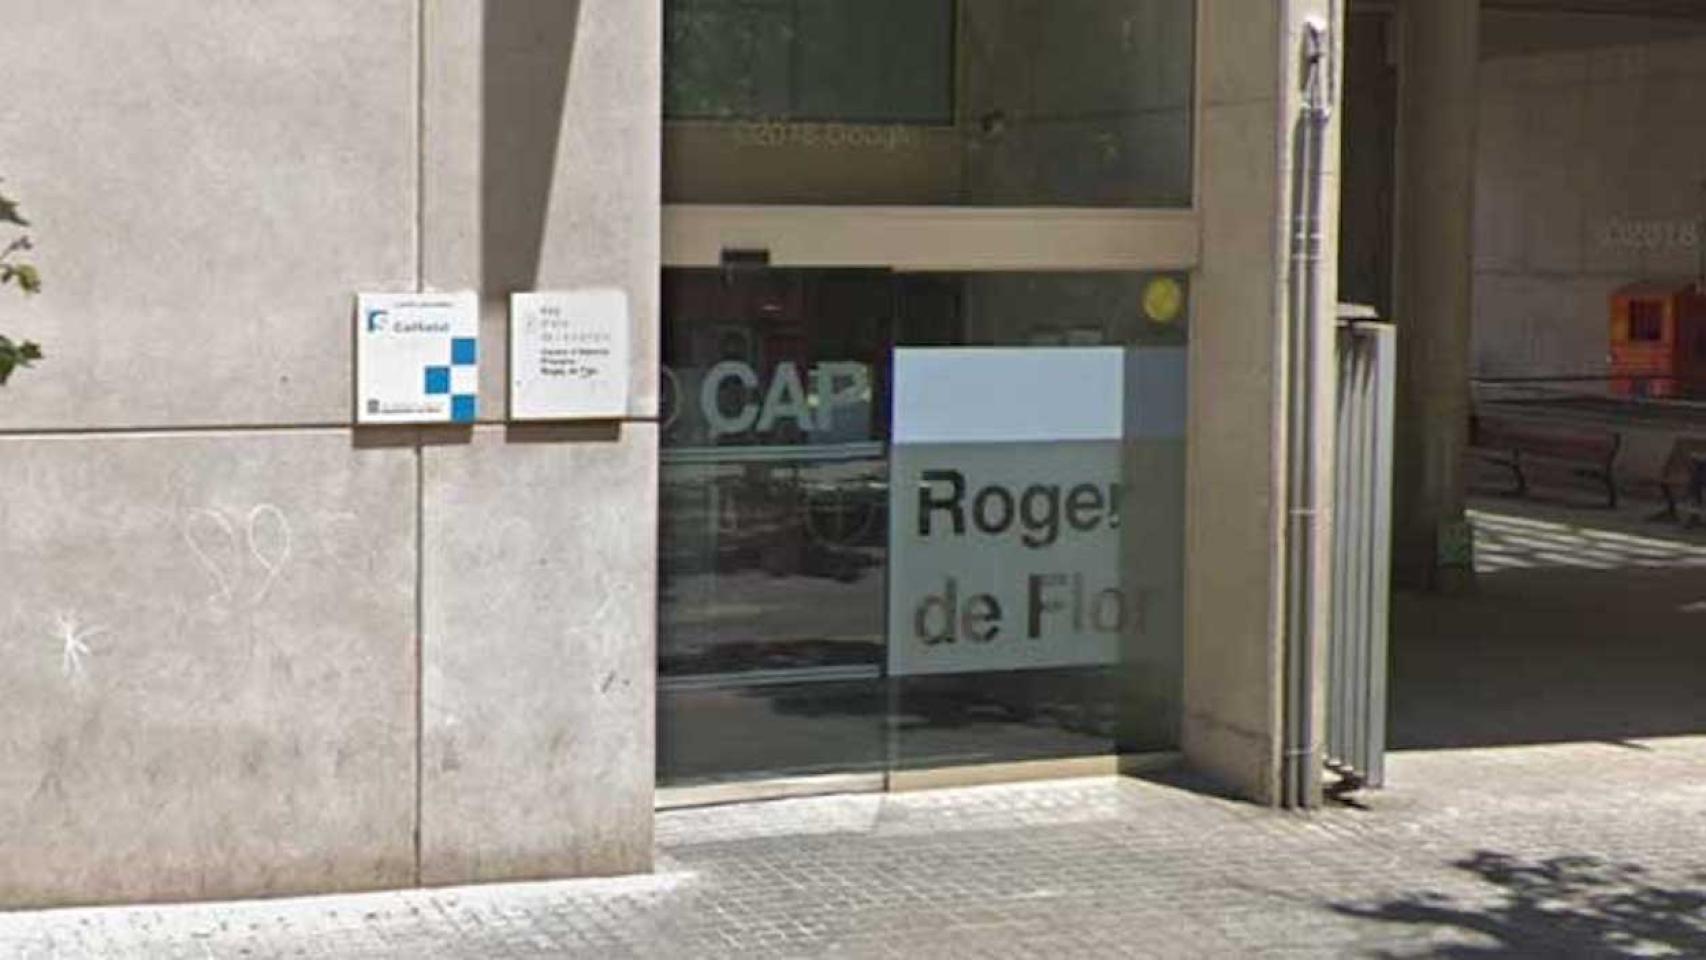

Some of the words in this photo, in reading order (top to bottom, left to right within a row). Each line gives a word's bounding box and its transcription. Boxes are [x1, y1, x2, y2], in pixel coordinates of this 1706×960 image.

[701, 360, 870, 433] CAP
[916, 469, 1126, 548] Roger
[914, 575, 1003, 645] de
[1026, 571, 1155, 639] Flor
